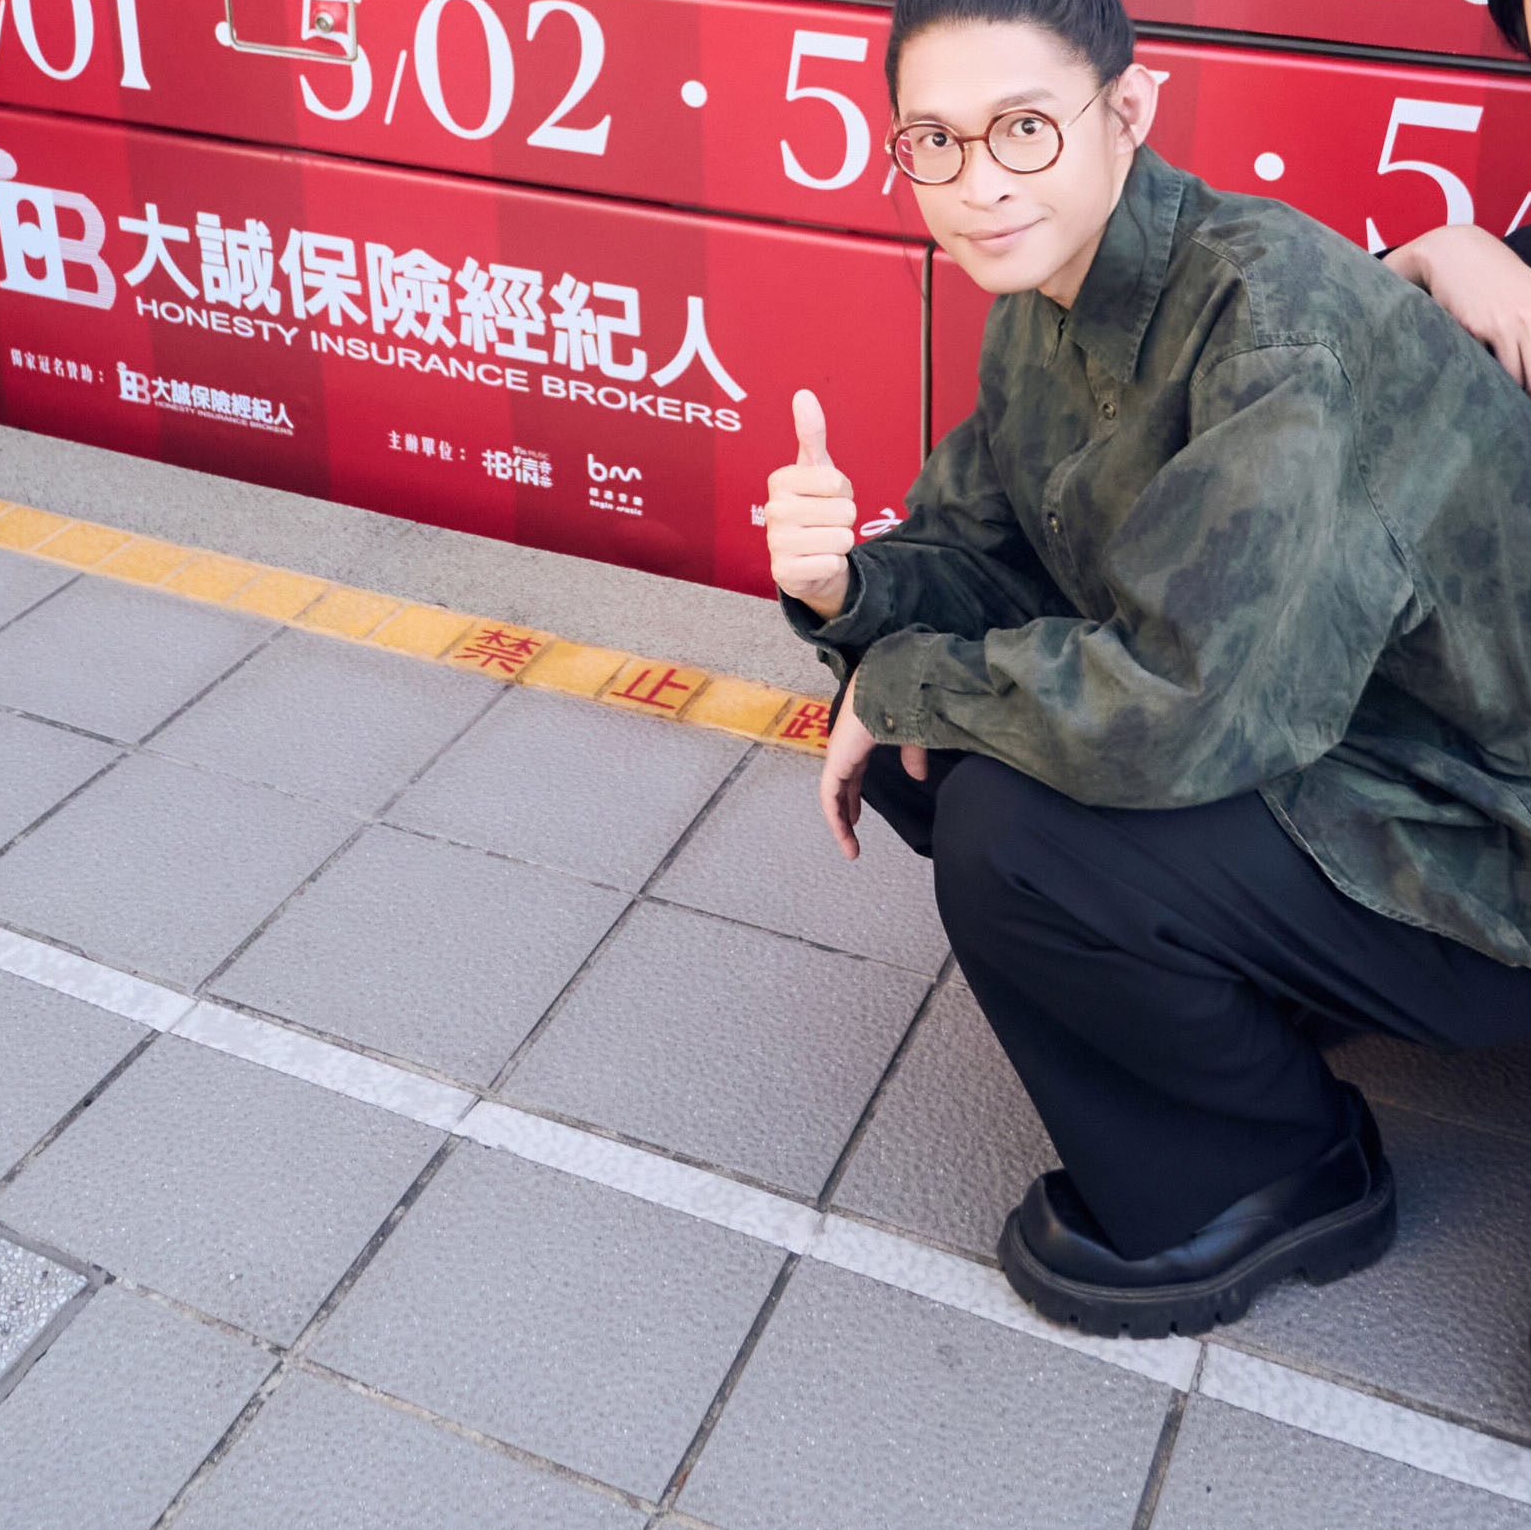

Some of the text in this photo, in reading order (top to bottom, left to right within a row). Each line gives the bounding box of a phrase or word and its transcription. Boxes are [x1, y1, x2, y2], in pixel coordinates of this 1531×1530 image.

[118, 202, 748, 403] 大誠保險經紀人
[135, 296, 743, 433] HONESTY INSURANCE BROKERS
